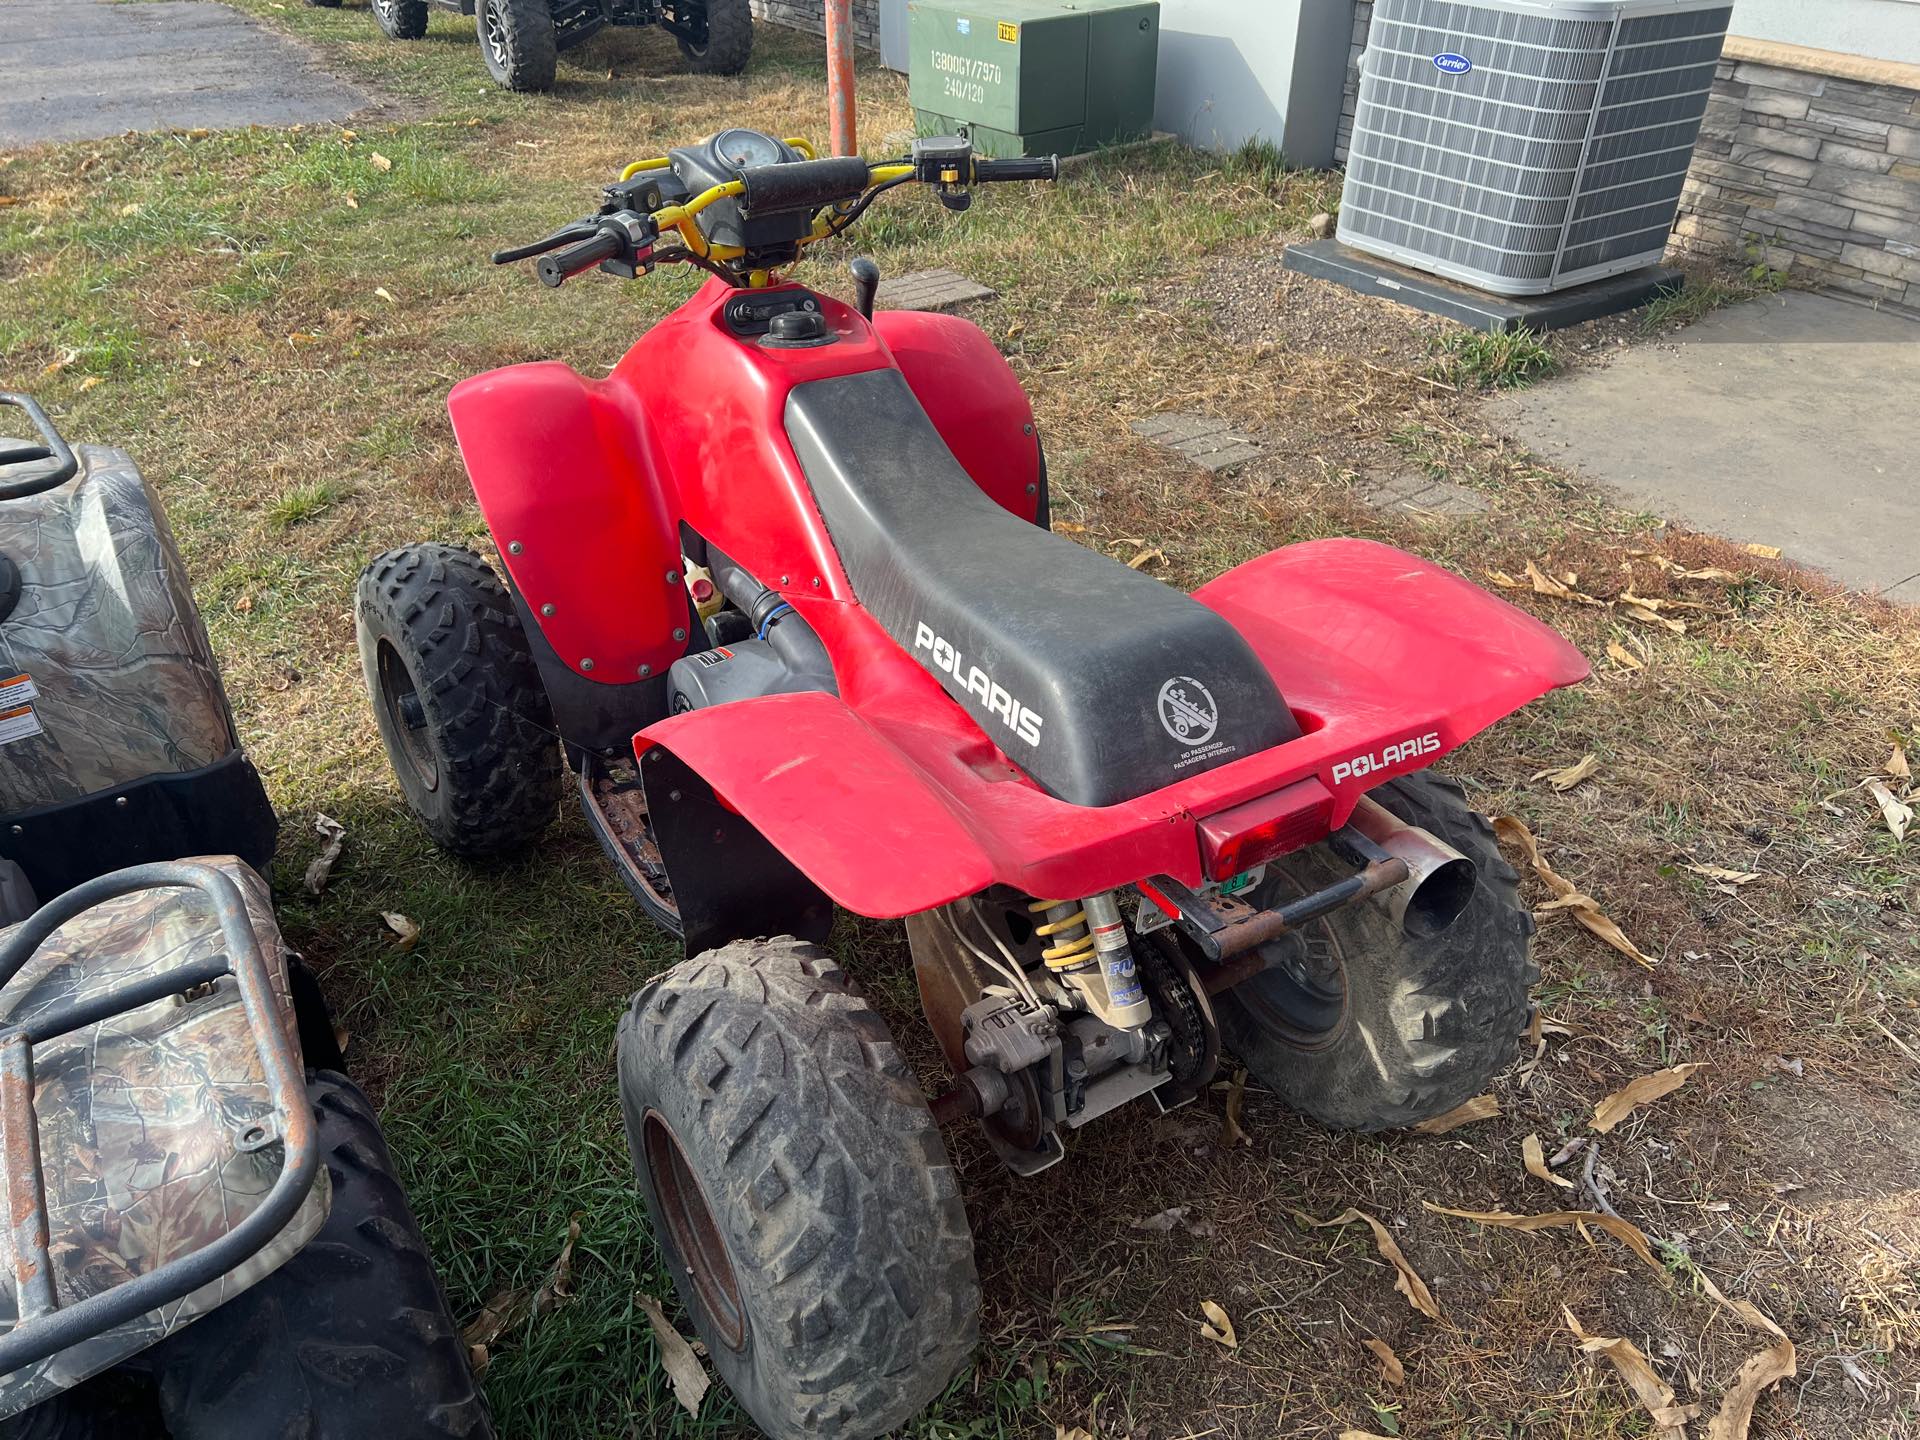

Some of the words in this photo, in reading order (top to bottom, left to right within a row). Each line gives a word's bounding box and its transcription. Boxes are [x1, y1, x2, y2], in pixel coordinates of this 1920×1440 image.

[931, 50, 1001, 85] 13800GY/7970
[1437, 56, 1466, 70] Carrier
[944, 76, 984, 104] 240/120
[915, 620, 1043, 748] POLARIS
[1173, 753, 1207, 770] PASSAGERS
[1207, 745, 1236, 758] INTERDITS
[1181, 751, 1190, 760] NO
[1190, 741, 1224, 756] PASSENGER
[1331, 732, 1441, 785] POLARIS
[1231, 876, 1238, 889] 8
